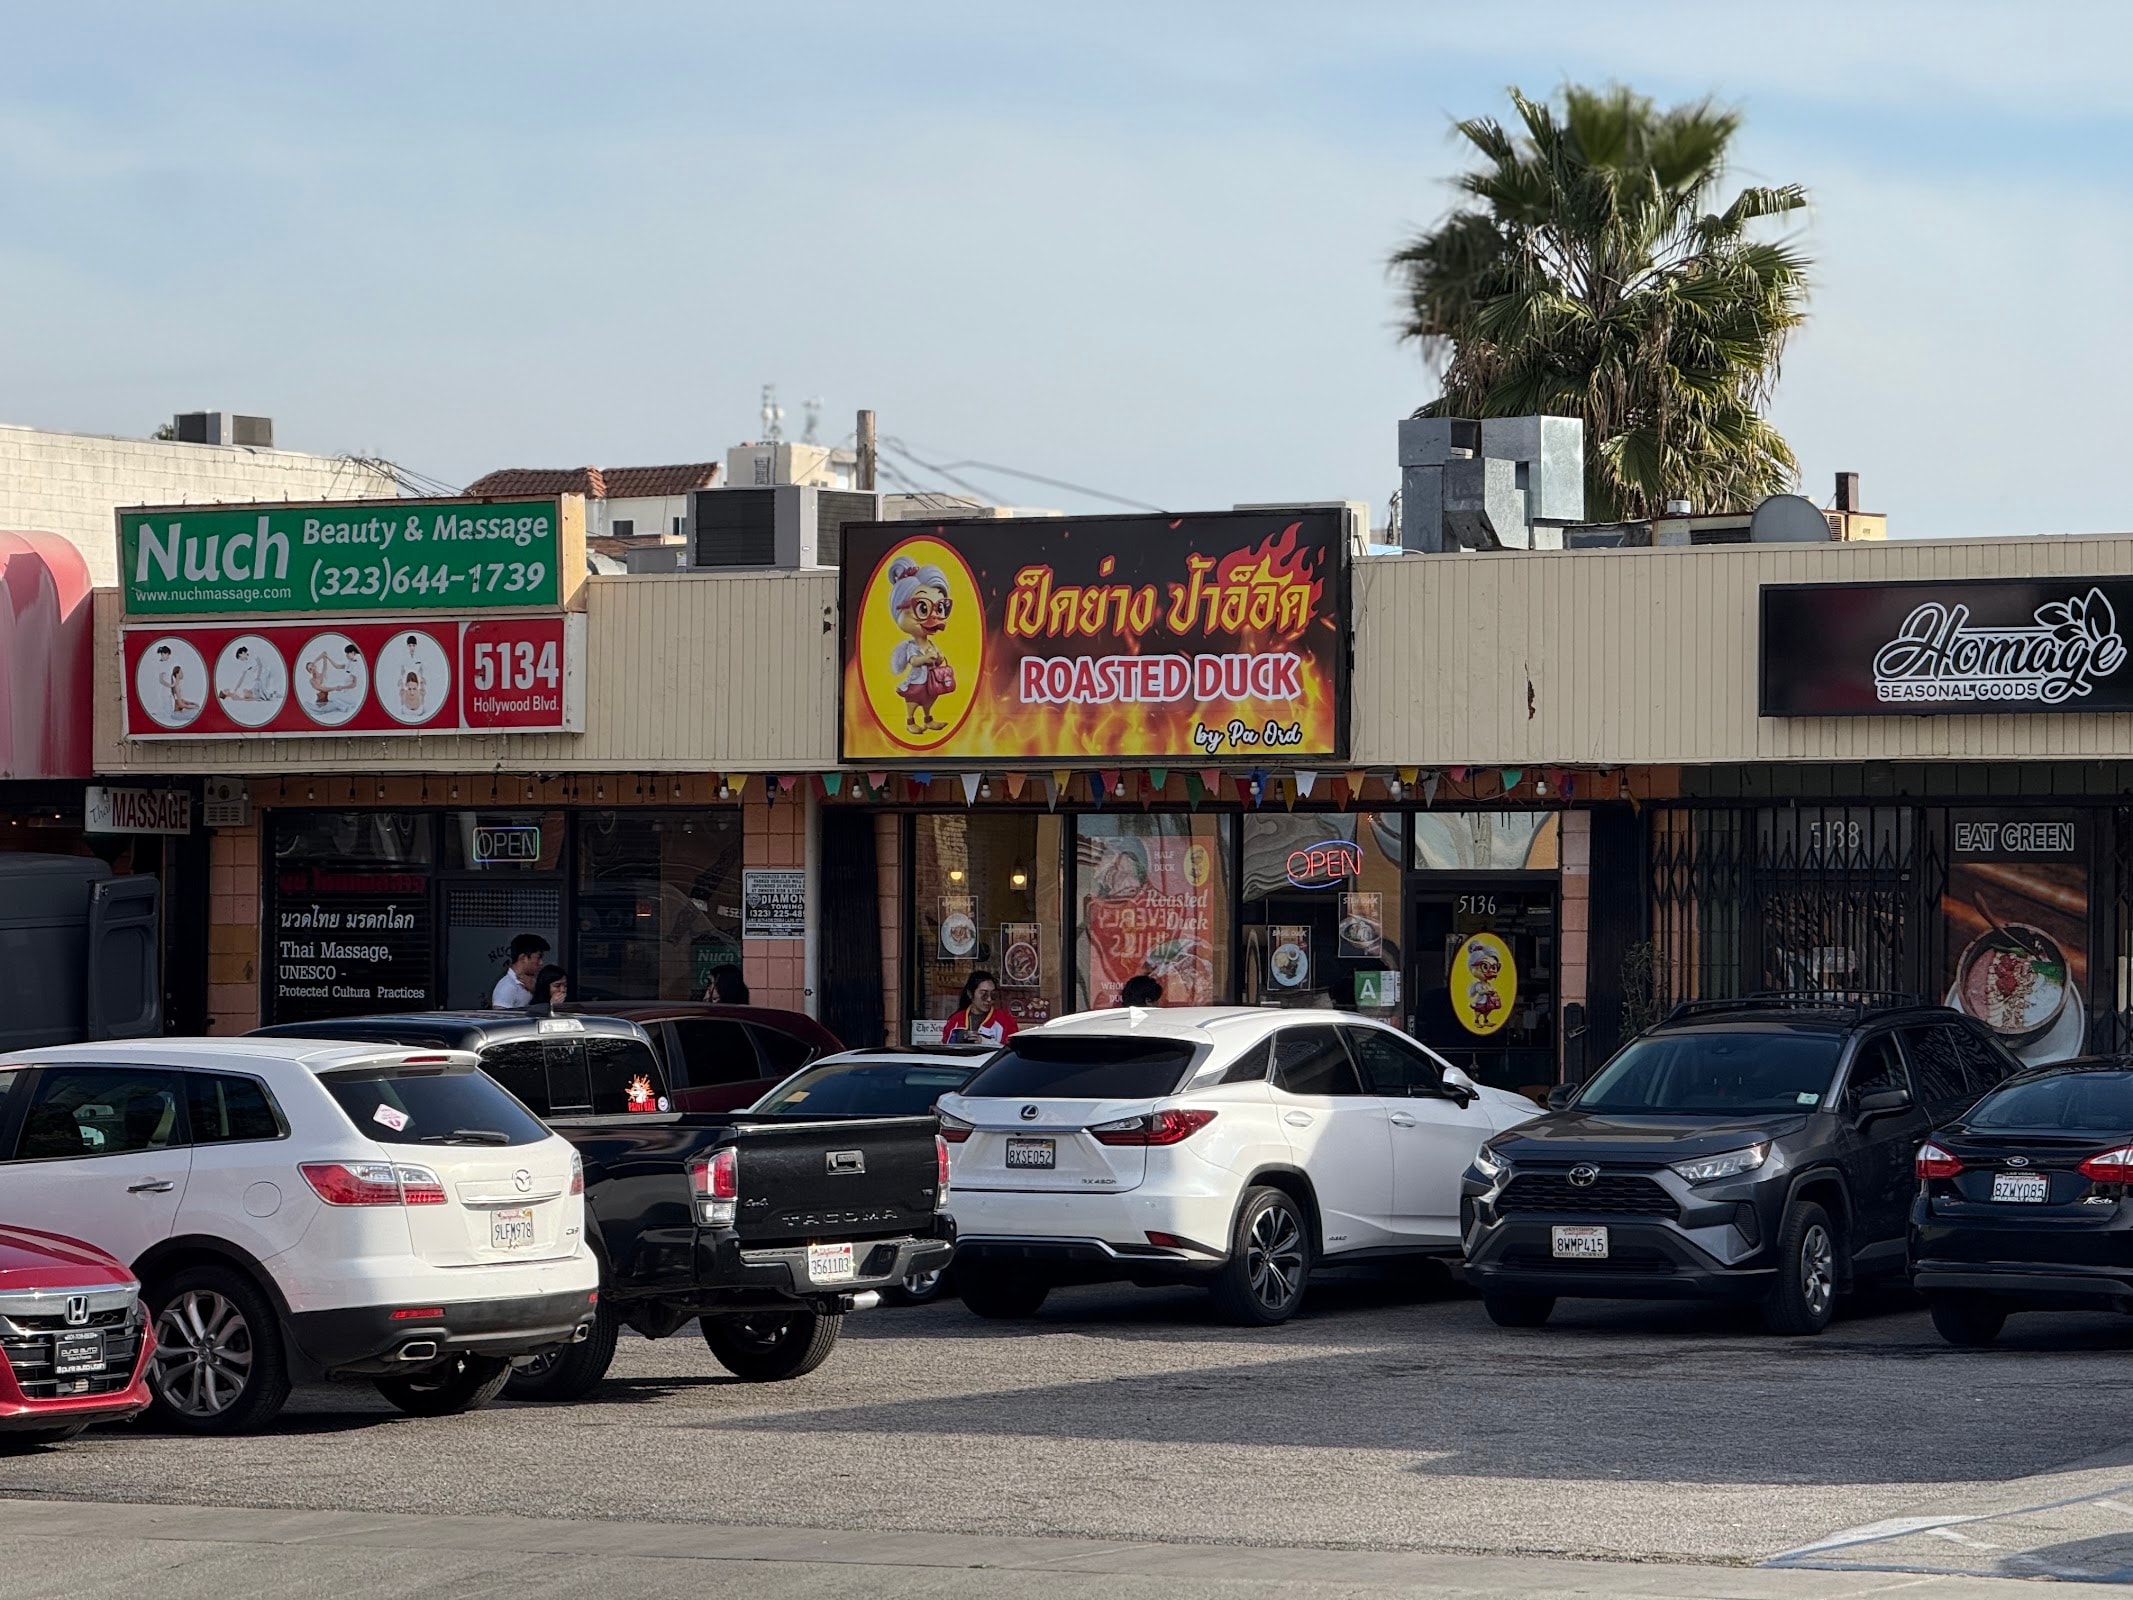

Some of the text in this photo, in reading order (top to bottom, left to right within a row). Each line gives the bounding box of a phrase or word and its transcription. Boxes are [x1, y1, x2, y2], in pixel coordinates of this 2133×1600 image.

[303, 514, 549, 550] Beauty & Massage
[136, 516, 290, 583] Nuch
[310, 557, 546, 603] (323)644-1739
[136, 585, 292, 603] www.nuchmassage.com
[1004, 555, 1157, 638] เป็ดย่าง
[1873, 602, 2127, 704] Homage
[474, 641, 559, 691] 5134
[1020, 653, 1301, 703] ROASTED DUCK
[1878, 683, 2038, 699] SEASONAL GOODS
[474, 695, 560, 716] Hollywood Blvd.
[1195, 719, 1301, 752] by Pa Ord
[112, 792, 188, 829] MASSAGE
[476, 832, 537, 858] OPEN
[1810, 821, 1860, 850] 5138
[1955, 822, 2075, 852] EAT GREEN
[1154, 850, 1175, 859] HALF
[1287, 849, 1362, 879] OPEN
[1154, 863, 1175, 872] DUCK
[1145, 889, 1209, 908] Roasted
[1457, 895, 1497, 916] 5136
[281, 904, 415, 929] นวดไทย มรดกโลก
[750, 910, 770, 918] (323)
[773, 910, 805, 918] 225-48
[1166, 911, 1209, 930] Duck
[279, 941, 393, 963] Thai Massage,
[279, 965, 337, 980] UNESCO
[278, 985, 329, 998] Protected
[376, 986, 425, 999] Practices
[1359, 979, 1377, 1000] A
[1009, 1150, 1052, 1164] 8XSE052
[1995, 1182, 2044, 1198] 8ZWY085
[781, 1209, 899, 1227] TACOMA
[495, 1223, 532, 1241] 9LFM978
[1557, 1238, 1604, 1252] 8WMP415
